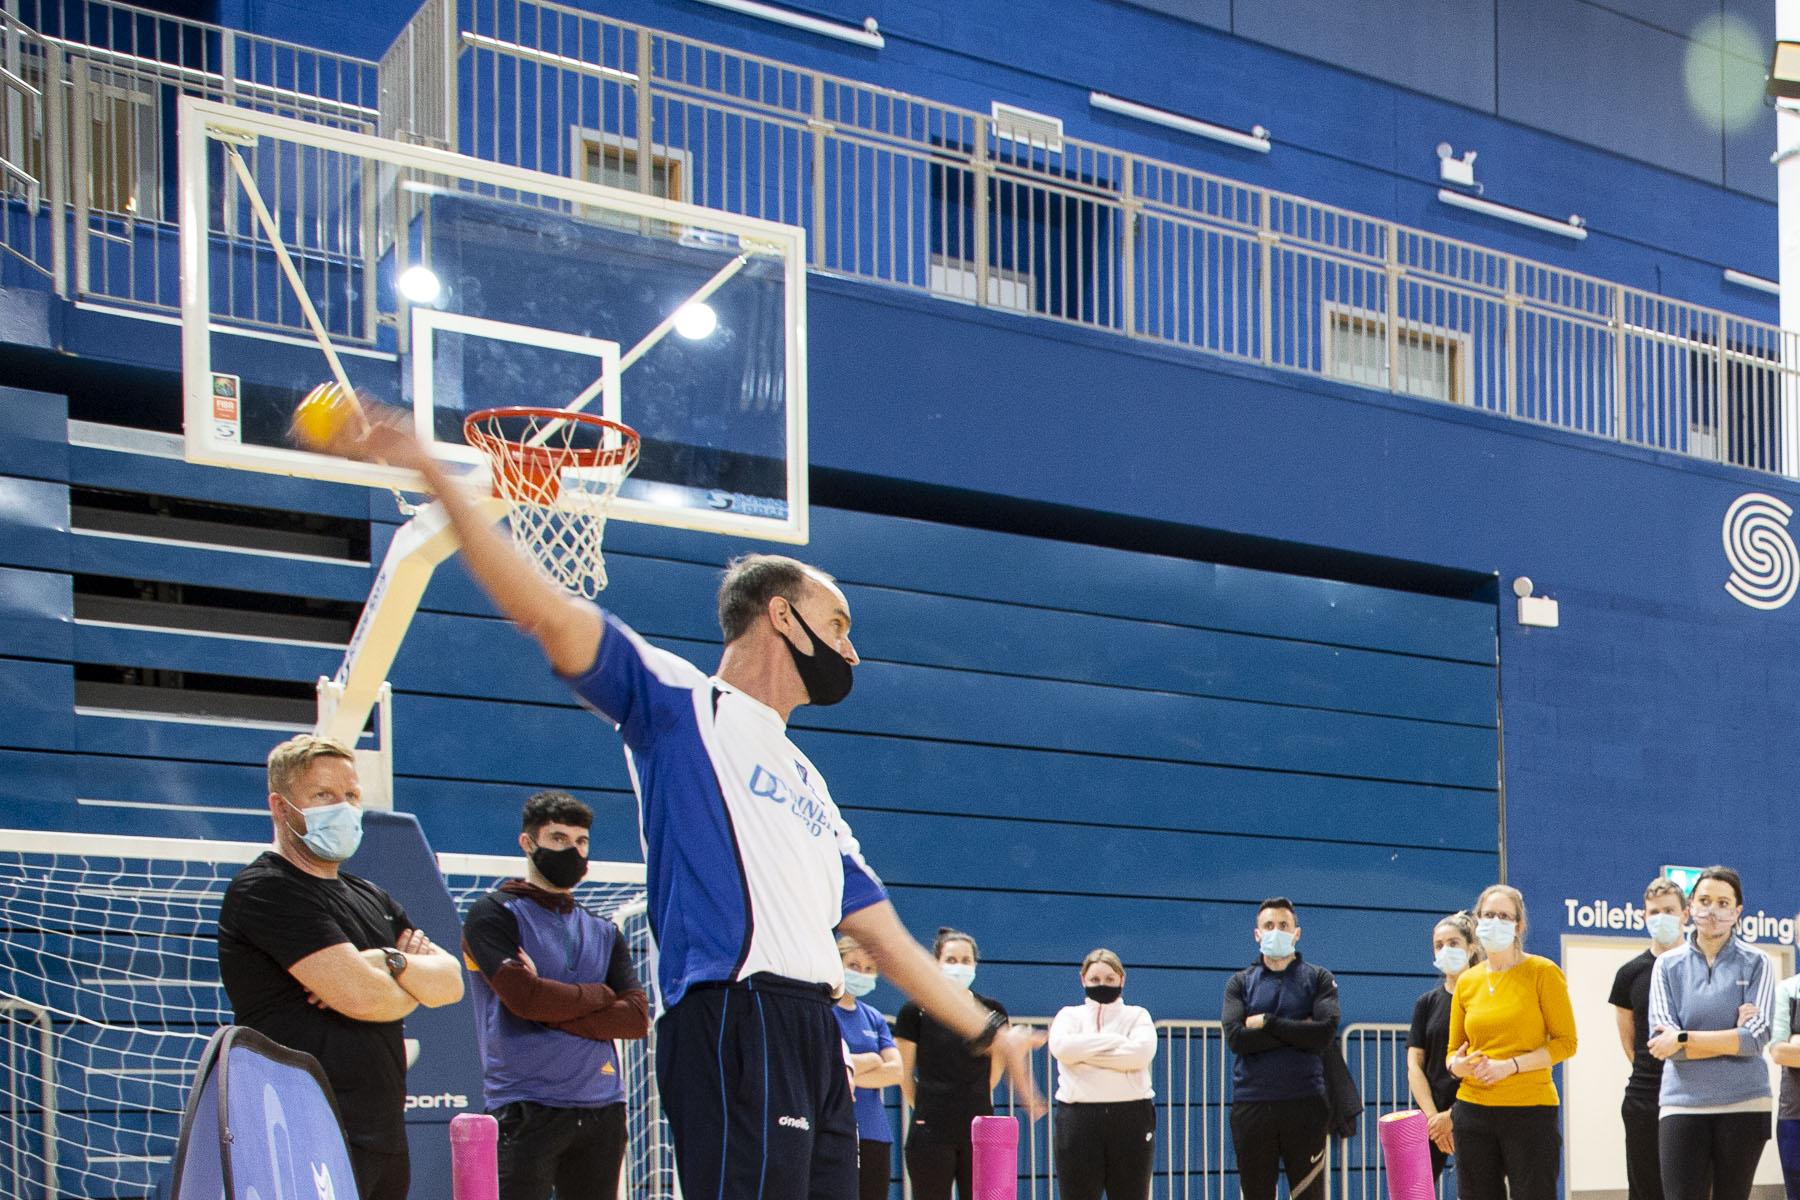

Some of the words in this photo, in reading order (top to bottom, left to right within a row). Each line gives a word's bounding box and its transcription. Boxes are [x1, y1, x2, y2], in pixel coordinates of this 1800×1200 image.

[1564, 898, 1646, 931] Toilets
[1737, 910, 1794, 944] ging
[403, 1092, 469, 1113] ports
